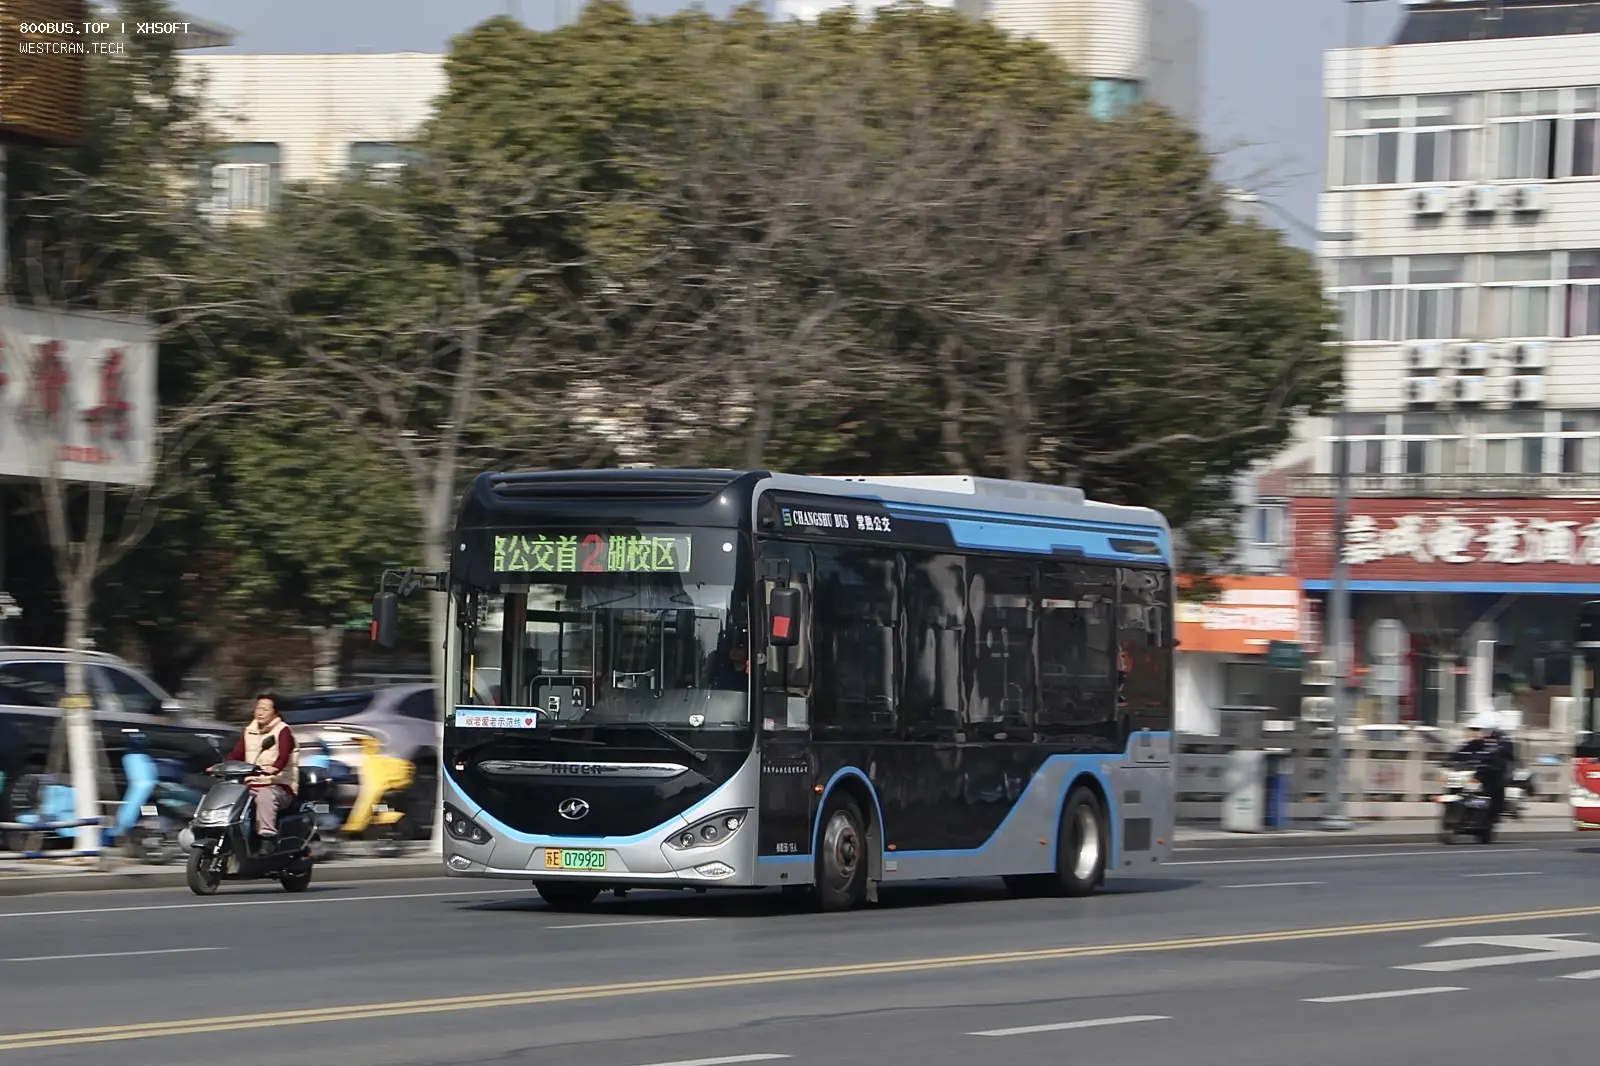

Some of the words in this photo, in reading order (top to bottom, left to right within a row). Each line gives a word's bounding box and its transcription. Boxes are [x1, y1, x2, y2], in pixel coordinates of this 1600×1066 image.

[792, 510, 833, 527] CHANGSHU
[834, 513, 850, 529] BUS
[856, 515, 892, 532] 常熟公交
[551, 763, 602, 775] HIGER
